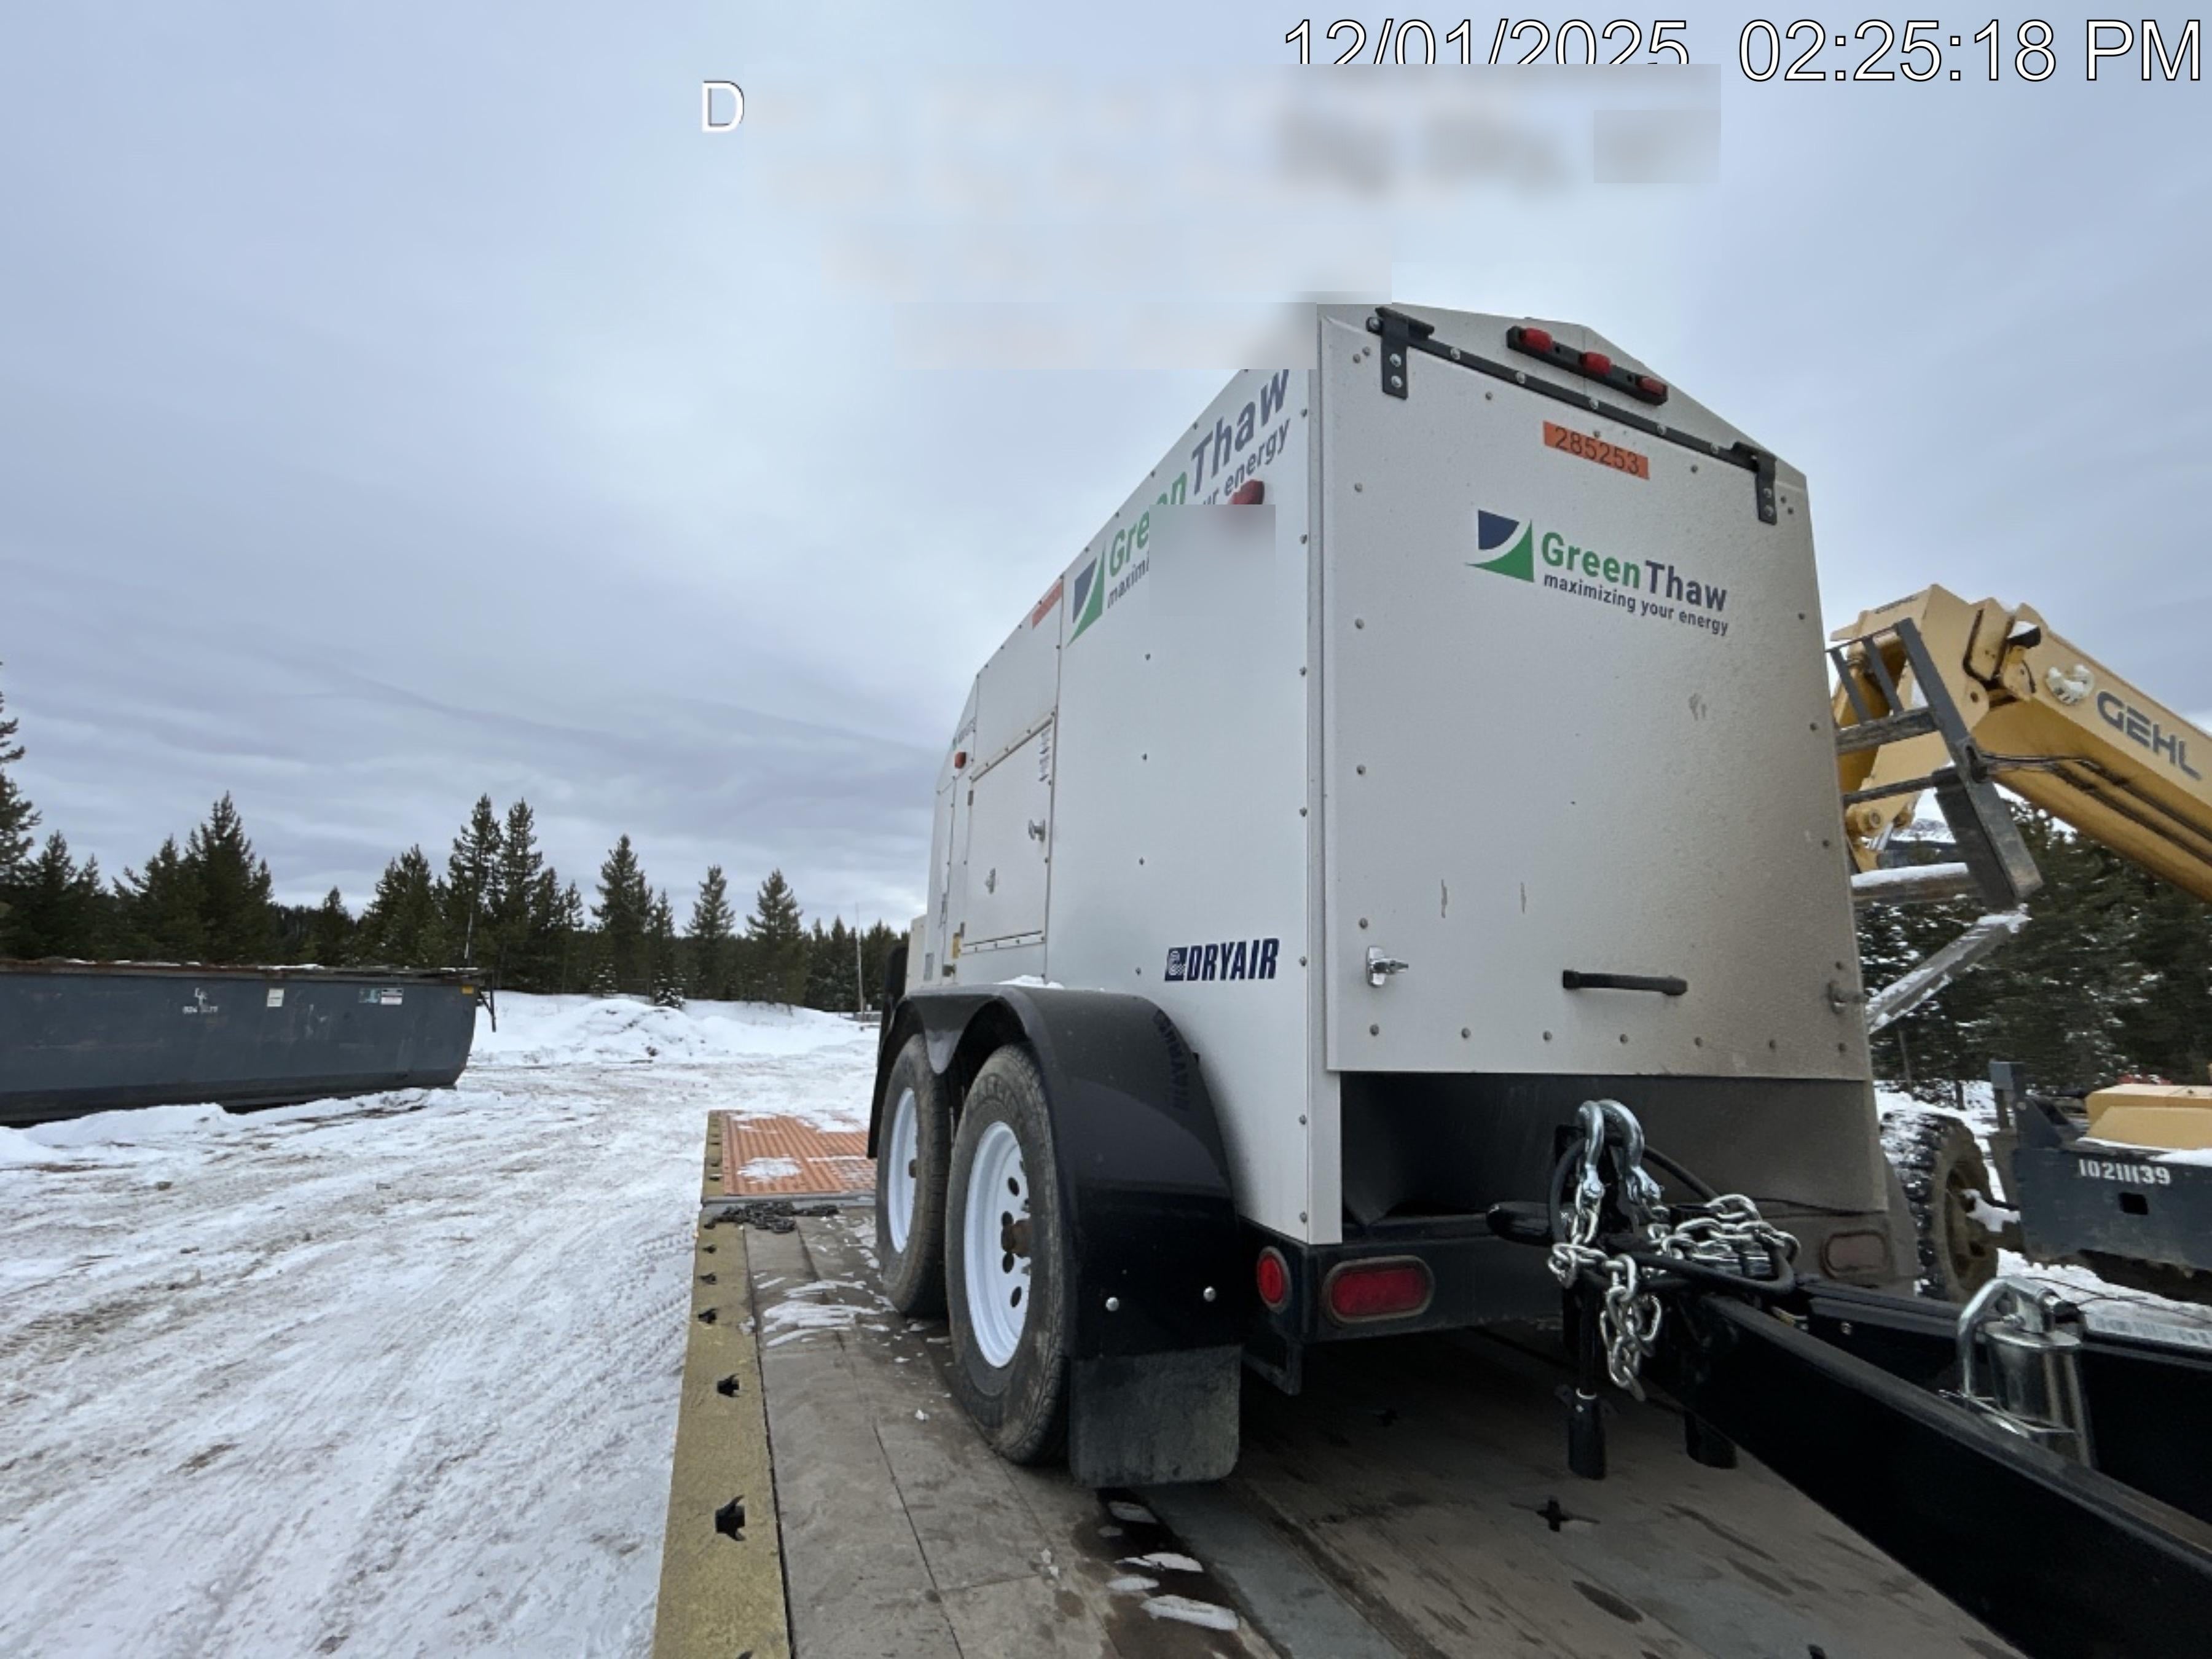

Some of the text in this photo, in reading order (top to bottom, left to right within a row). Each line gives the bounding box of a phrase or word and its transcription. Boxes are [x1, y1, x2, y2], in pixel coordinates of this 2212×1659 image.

[1224, 417, 1291, 497] energy
[1555, 428, 1640, 475] 285253
[1543, 572, 1728, 636] maximizing your energy
[2096, 691, 2202, 782] GEHL
[1186, 938, 1279, 981] DRYAIR
[2079, 1158, 2171, 1186] 10211139
